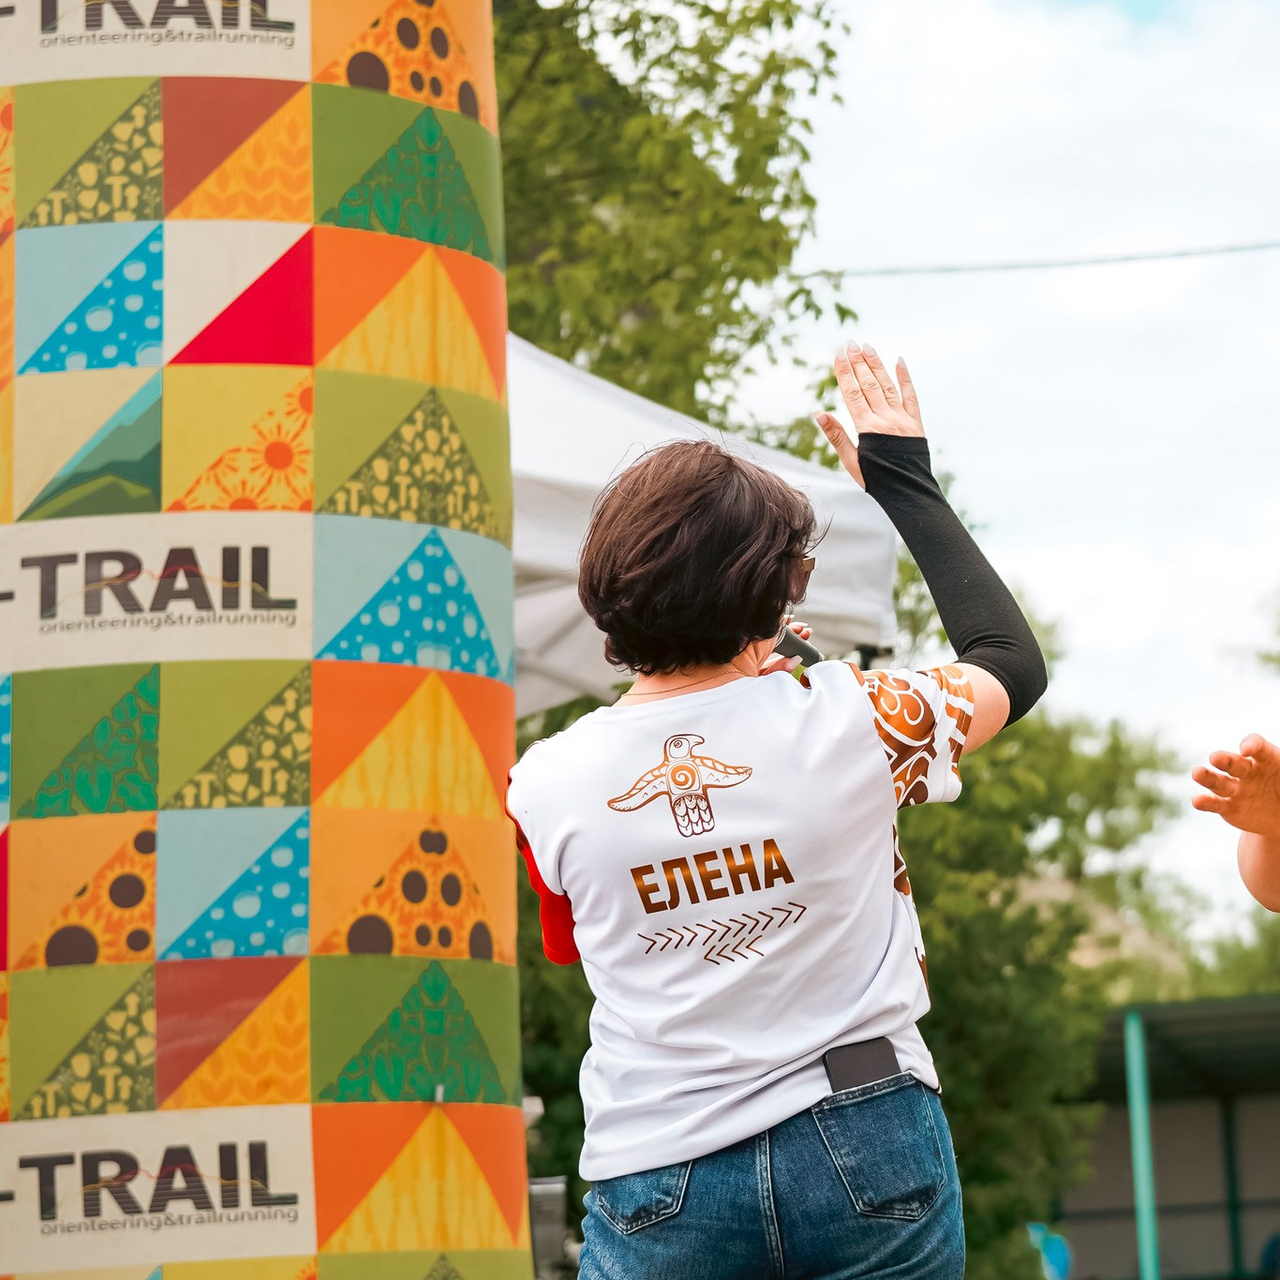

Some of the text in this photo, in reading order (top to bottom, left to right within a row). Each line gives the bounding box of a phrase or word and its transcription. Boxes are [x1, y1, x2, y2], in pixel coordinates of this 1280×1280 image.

[40, 27, 296, 50] orienteering&trailrunning
[39, 610, 297, 635] orienteering&trailrunning
[630, 838, 795, 914] ЕЛЕНА
[40, 1206, 299, 1235] orienteering&trailrunning
